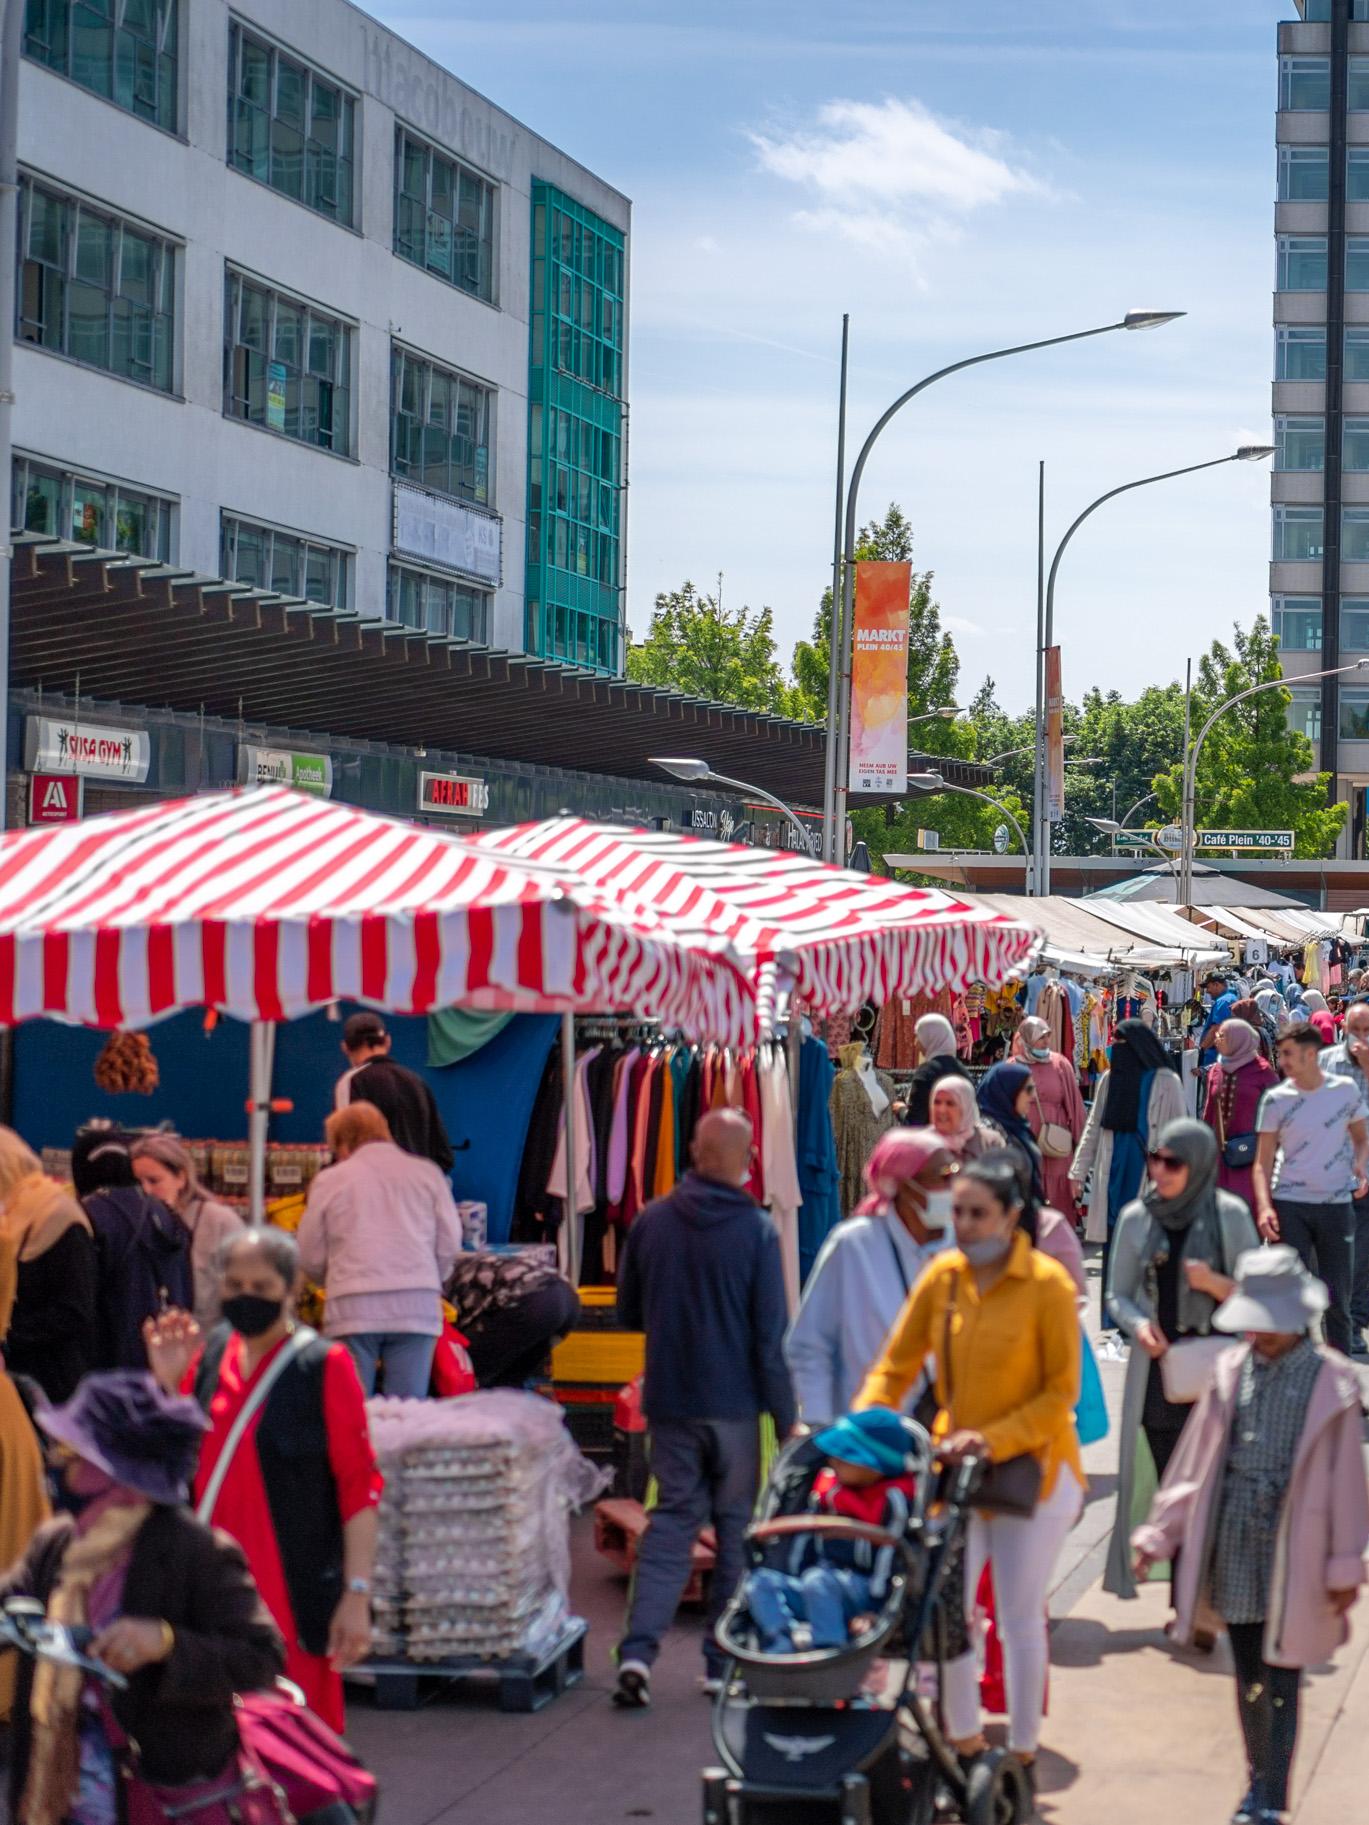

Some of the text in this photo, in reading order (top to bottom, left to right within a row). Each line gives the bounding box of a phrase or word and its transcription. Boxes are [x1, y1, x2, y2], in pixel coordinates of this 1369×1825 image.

[858, 629, 905, 641] MARKT
[857, 643, 878, 651] PLEIN
[99, 740, 121, 766] GYM
[296, 765, 322, 782] Apotheek
[432, 779, 468, 807] AFRAH
[1204, 834, 1226, 845] Café
[1228, 834, 1253, 845] Plein
[1252, 949, 1260, 960] 6
